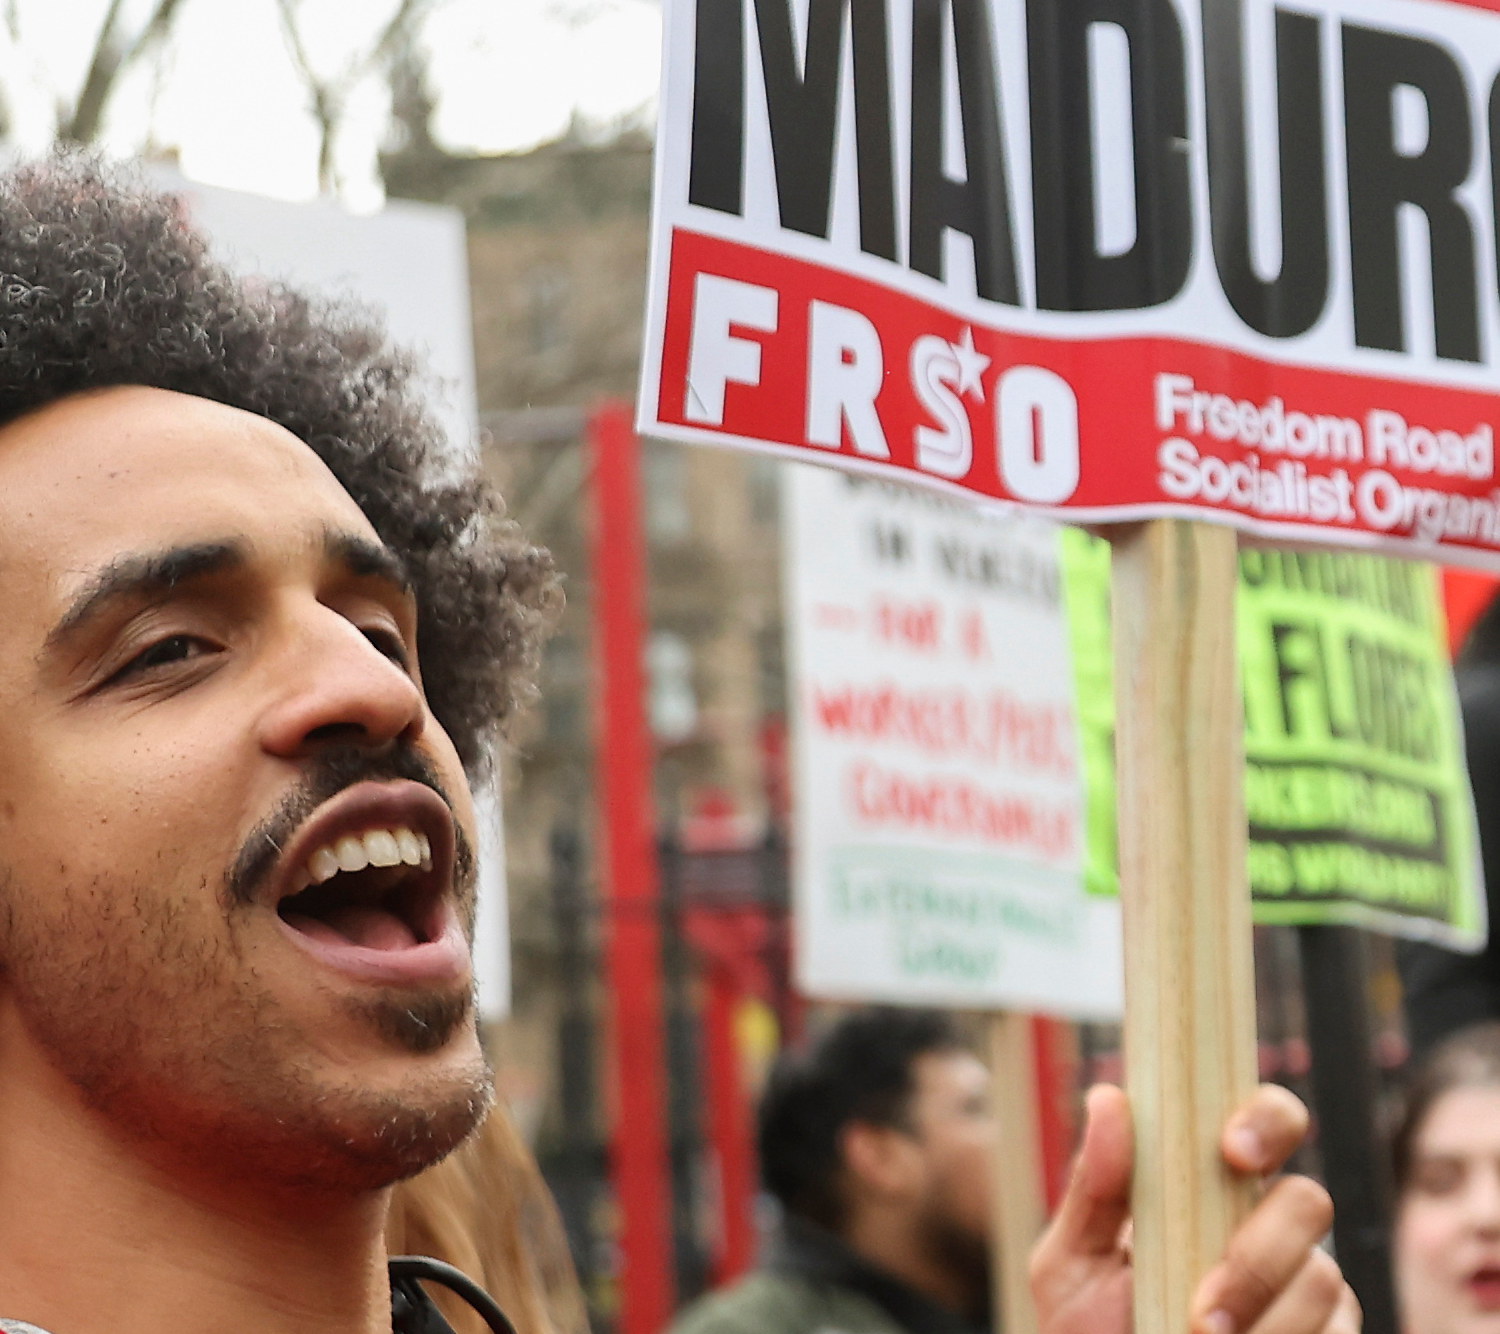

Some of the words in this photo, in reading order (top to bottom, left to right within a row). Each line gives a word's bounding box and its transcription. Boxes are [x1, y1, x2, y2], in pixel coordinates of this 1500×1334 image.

[1154, 371, 1364, 462] Freedom
[1366, 408, 1495, 480] Road
[1156, 436, 1355, 523] Socialist
